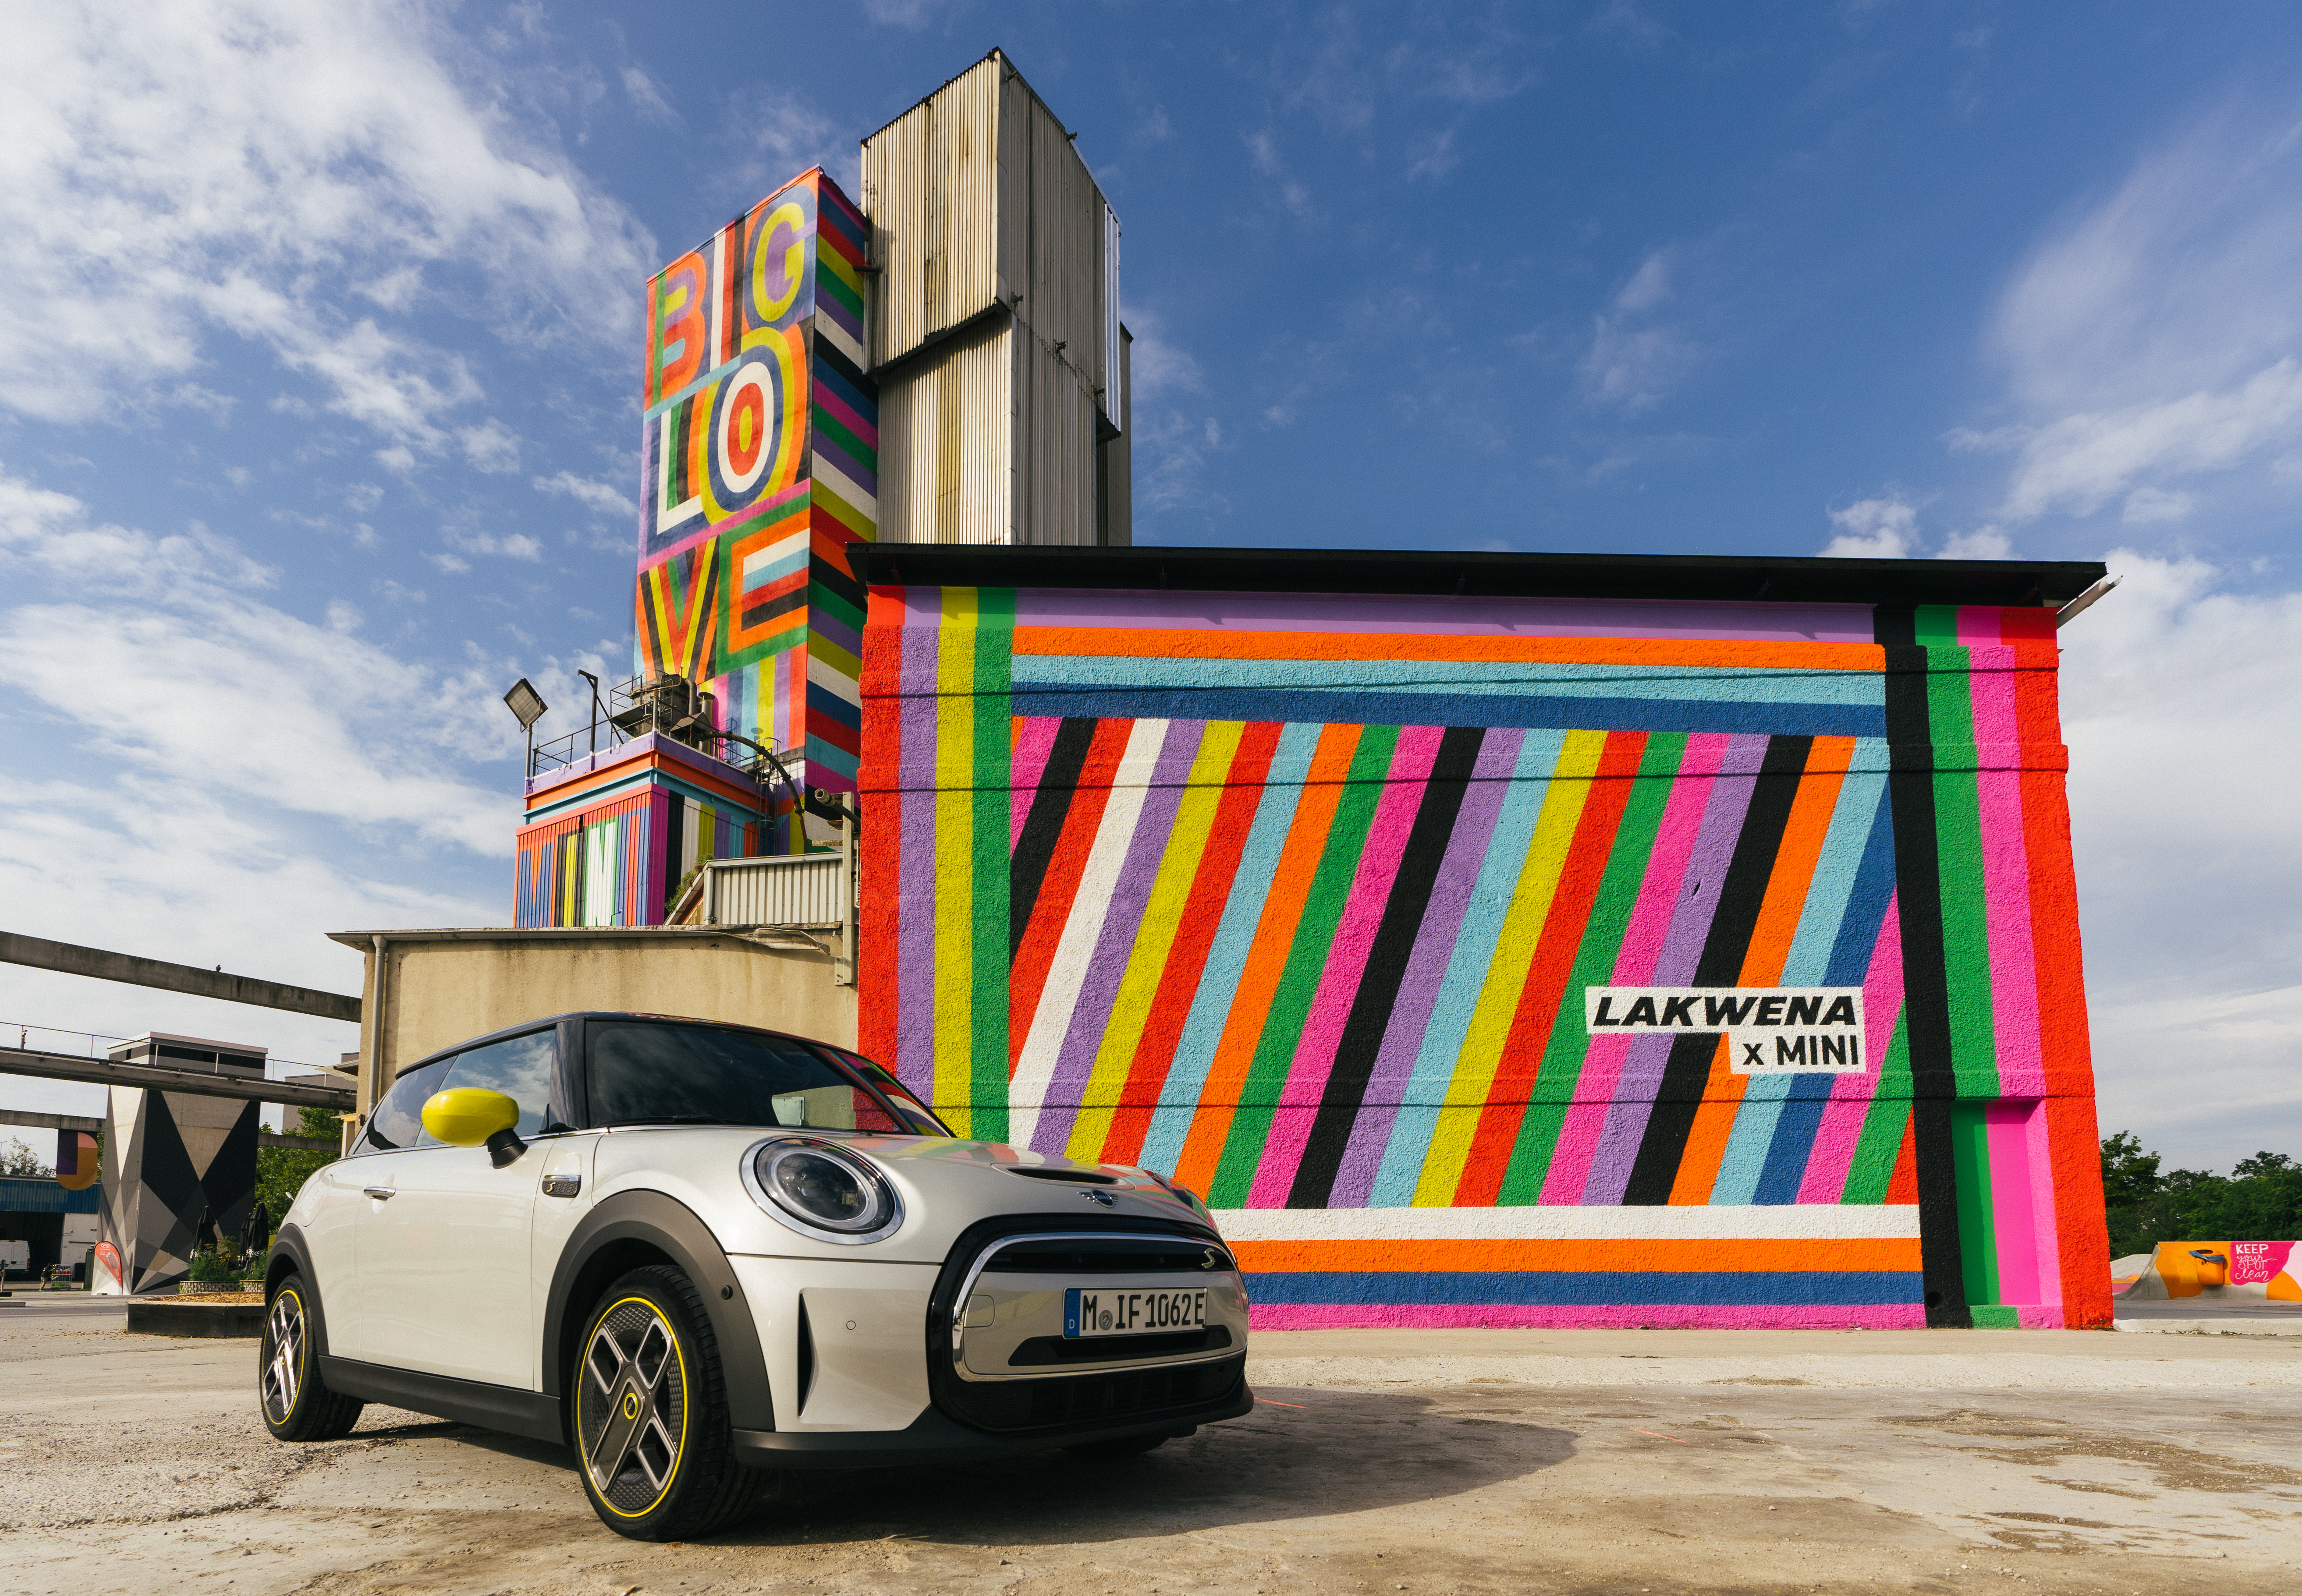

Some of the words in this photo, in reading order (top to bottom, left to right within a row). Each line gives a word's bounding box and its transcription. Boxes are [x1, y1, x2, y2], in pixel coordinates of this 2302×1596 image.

[644, 184, 816, 407] BIG
[1593, 996, 1856, 1026] LAKWENA
[1776, 1035, 1859, 1065] MINI
[1202, 1248, 1215, 1268] S
[2235, 1244, 2269, 1254] KEEP
[2236, 1255, 2277, 1263] your
[2235, 1268, 2269, 1281] clean
[2238, 1260, 2268, 1270] SPOT
[1069, 1319, 1075, 1329] D
[1082, 1295, 1097, 1330] M
